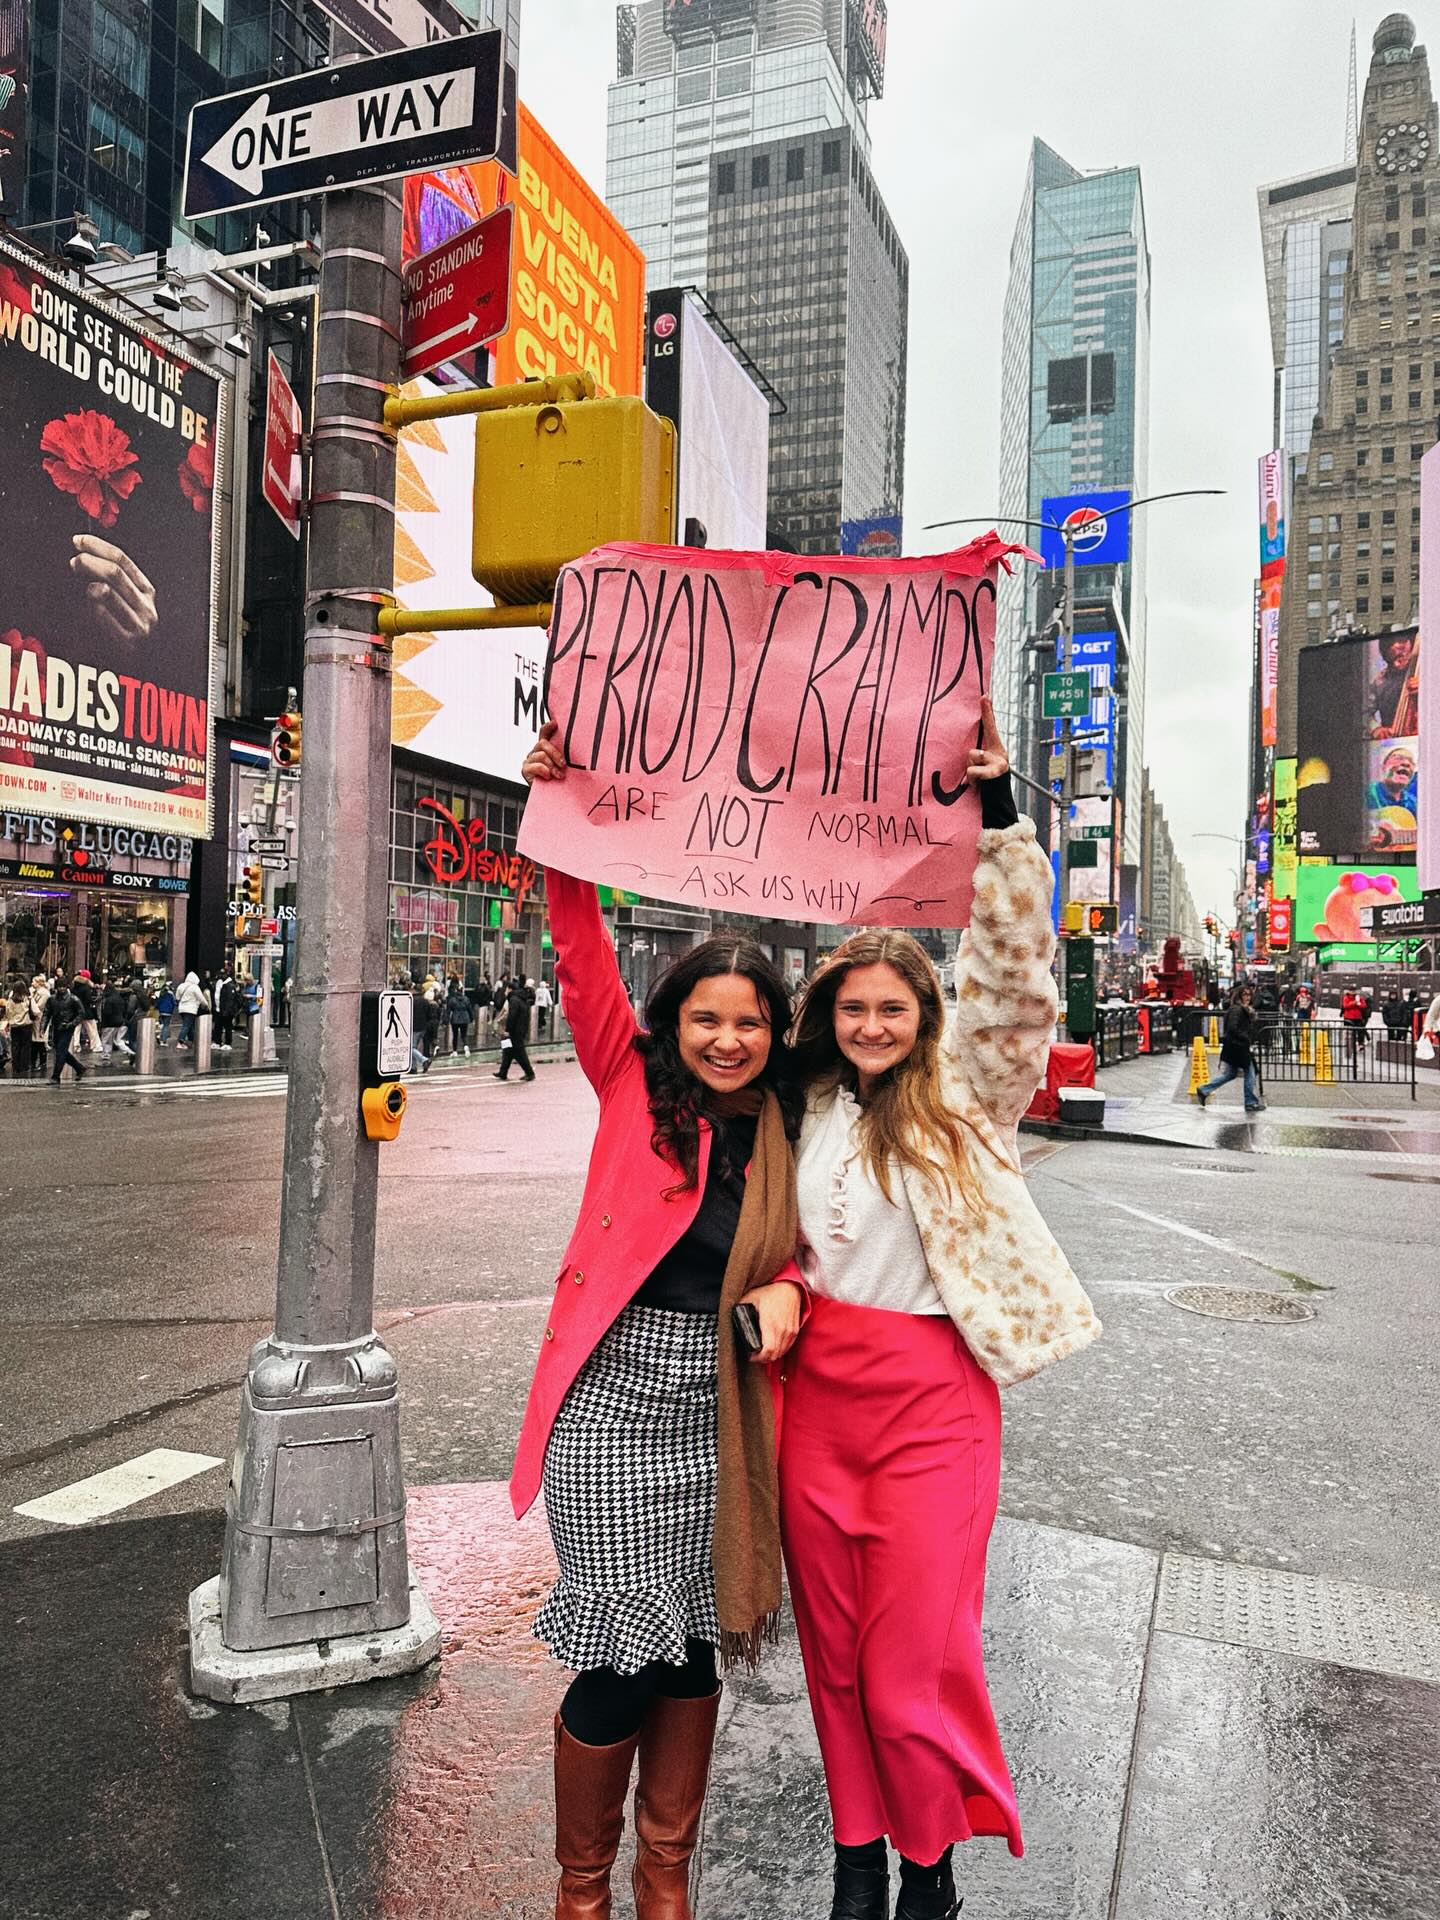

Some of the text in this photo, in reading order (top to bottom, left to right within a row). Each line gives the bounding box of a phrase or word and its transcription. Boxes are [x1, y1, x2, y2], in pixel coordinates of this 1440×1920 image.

[231, 79, 455, 170] ONE WAY
[357, 167, 377, 176] DEPT
[406, 147, 482, 166] TRANSPORTATION
[520, 156, 618, 301] BUENA
[408, 234, 484, 292] NO STANDING
[519, 206, 617, 352] VISTA
[408, 282, 454, 321] Anytime
[31, 283, 183, 395] COME SEE HOW THE
[516, 270, 617, 398] SOCIAL
[655, 341, 674, 357] LG
[0, 299, 208, 448] WORLD COULD BE
[514, 653, 538, 681] THE
[1083, 641, 1111, 653] GET
[542, 567, 996, 807] PERIOD CRAMPS
[1050, 691, 1058, 699] W
[1058, 690, 1072, 699] 45
[1061, 677, 1073, 687] TO
[0, 736, 16, 749] DAM
[22, 740, 49, 755] LONDON
[54, 747, 91, 764] MELBOURNE
[96, 756, 109, 767] NEW
[111, 759, 126, 771] YORK
[143, 766, 160, 778] PAULO
[164, 771, 181, 782] SEOUL
[185, 775, 205, 787] SYDNEY
[79, 733, 134, 761] GLOBAL
[136, 745, 205, 774] SENSATION
[78, 787, 103, 801] Walter
[106, 792, 122, 806] Kerr
[124, 796, 151, 812] Theatre
[154, 801, 166, 814] 219
[587, 785, 953, 859] ARE NOT NORMAL
[0, 812, 193, 862] FTS LUGGAGE
[1092, 827, 1103, 837] 46
[19, 864, 55, 879] Nikon
[61, 868, 105, 884] Canon
[113, 874, 153, 887] SONY
[159, 878, 188, 890] BOWER
[65, 849, 113, 871] I NY
[680, 865, 860, 912] ASK US WHY
